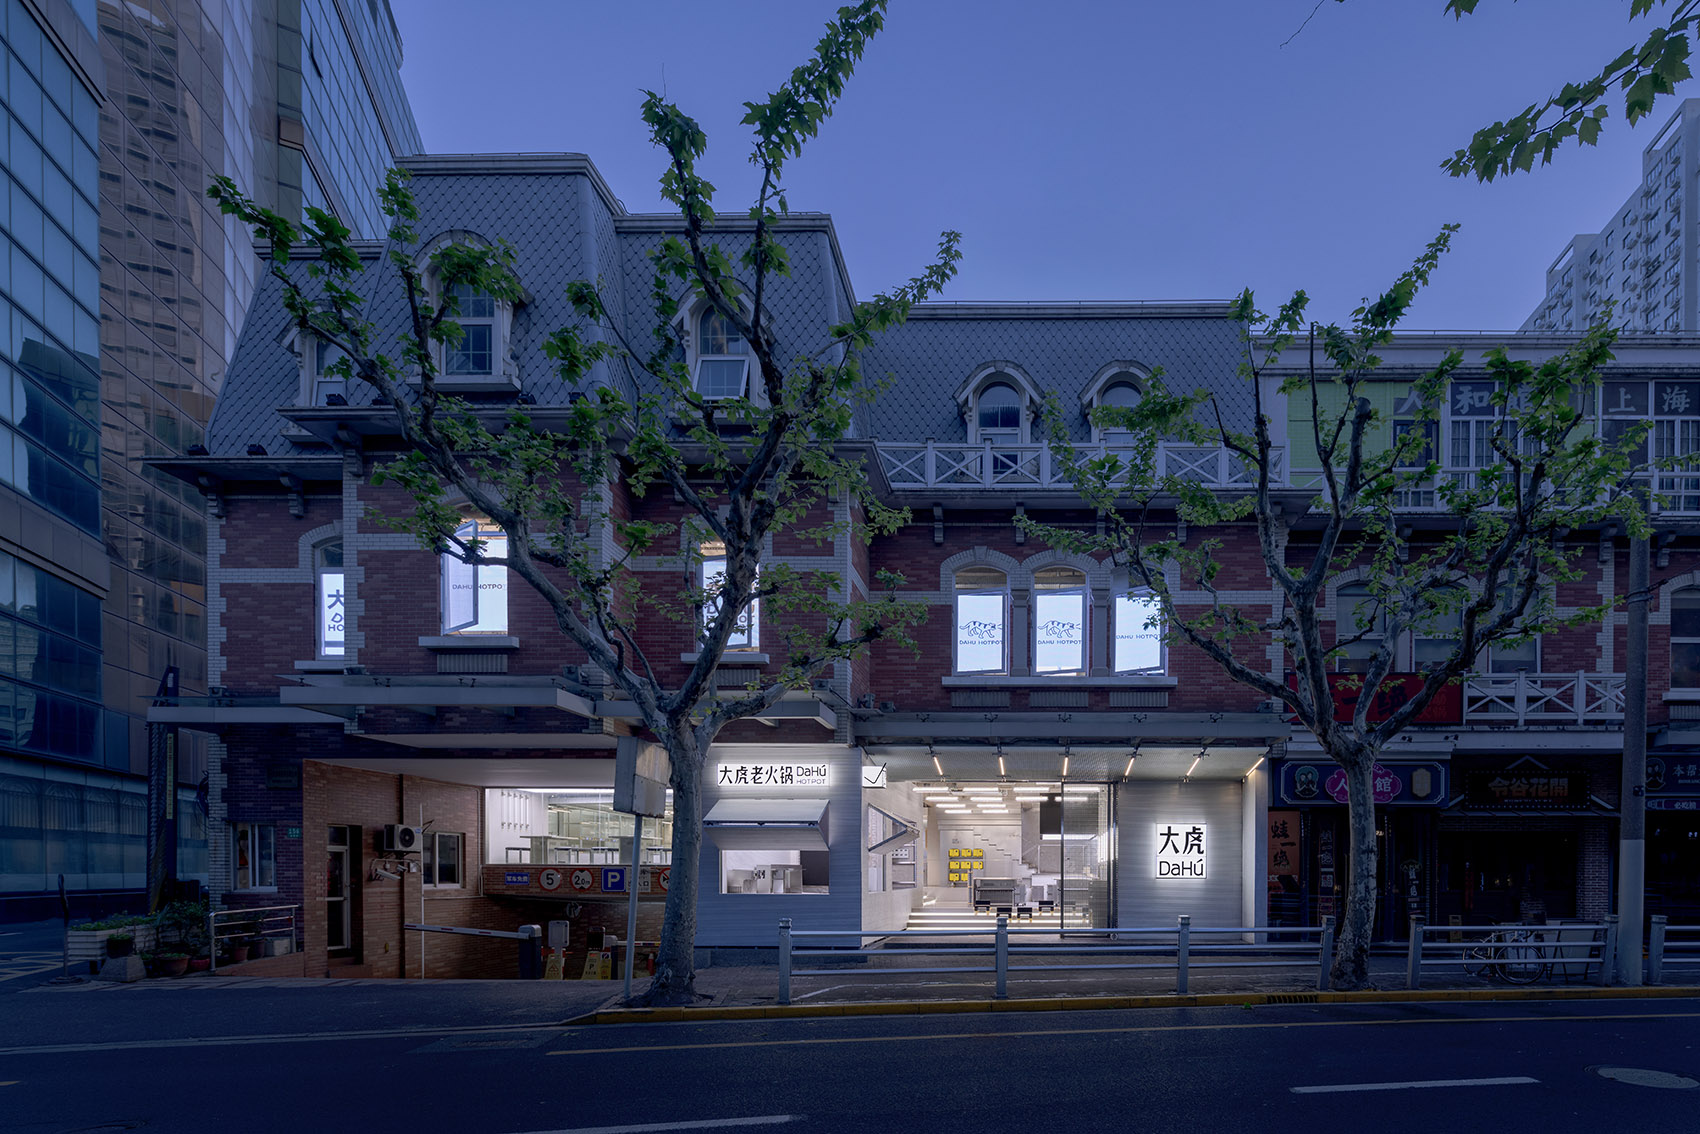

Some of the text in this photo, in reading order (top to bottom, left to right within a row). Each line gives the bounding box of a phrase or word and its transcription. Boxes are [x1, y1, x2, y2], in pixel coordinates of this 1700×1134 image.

[1608, 385, 1690, 413] 上海
[719, 766, 793, 784] 大虎老火锅
[796, 765, 827, 777] DaHú
[1335, 776, 1392, 792] 人館
[1158, 826, 1205, 854] 大虎
[1159, 858, 1204, 876] DaHú
[545, 873, 555, 886] 5
[574, 875, 592, 886] 2.0m
[608, 873, 622, 889] P
